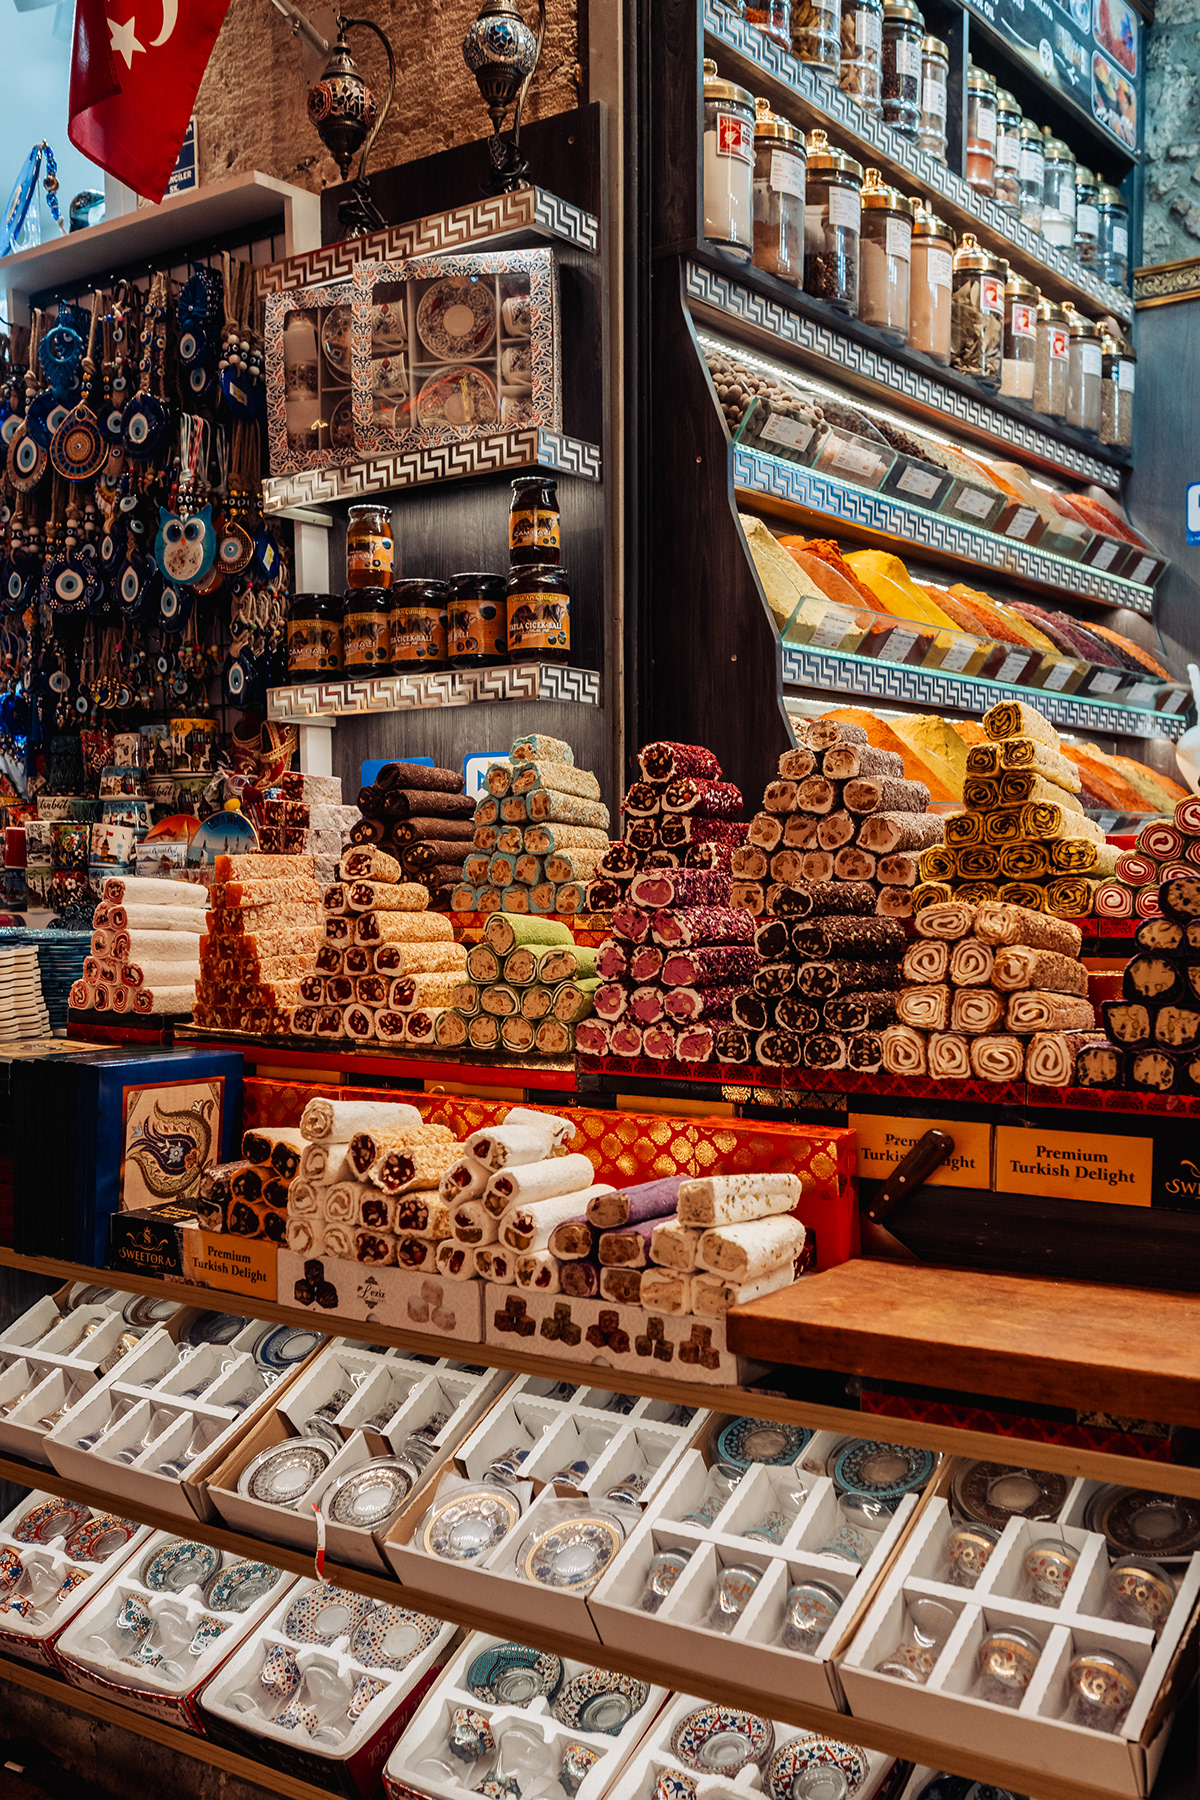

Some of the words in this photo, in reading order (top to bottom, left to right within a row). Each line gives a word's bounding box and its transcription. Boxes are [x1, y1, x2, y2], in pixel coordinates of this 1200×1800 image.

[861, 1148, 909, 1162] Turkis
[1036, 1145, 1108, 1163] Premium
[1010, 1160, 1070, 1177] Turkish
[1075, 1165, 1136, 1186] Delight
[119, 1246, 176, 1267] SWEETORA
[207, 1245, 251, 1264] Premium
[192, 1256, 229, 1274] Turkish
[231, 1264, 267, 1283] Delight
